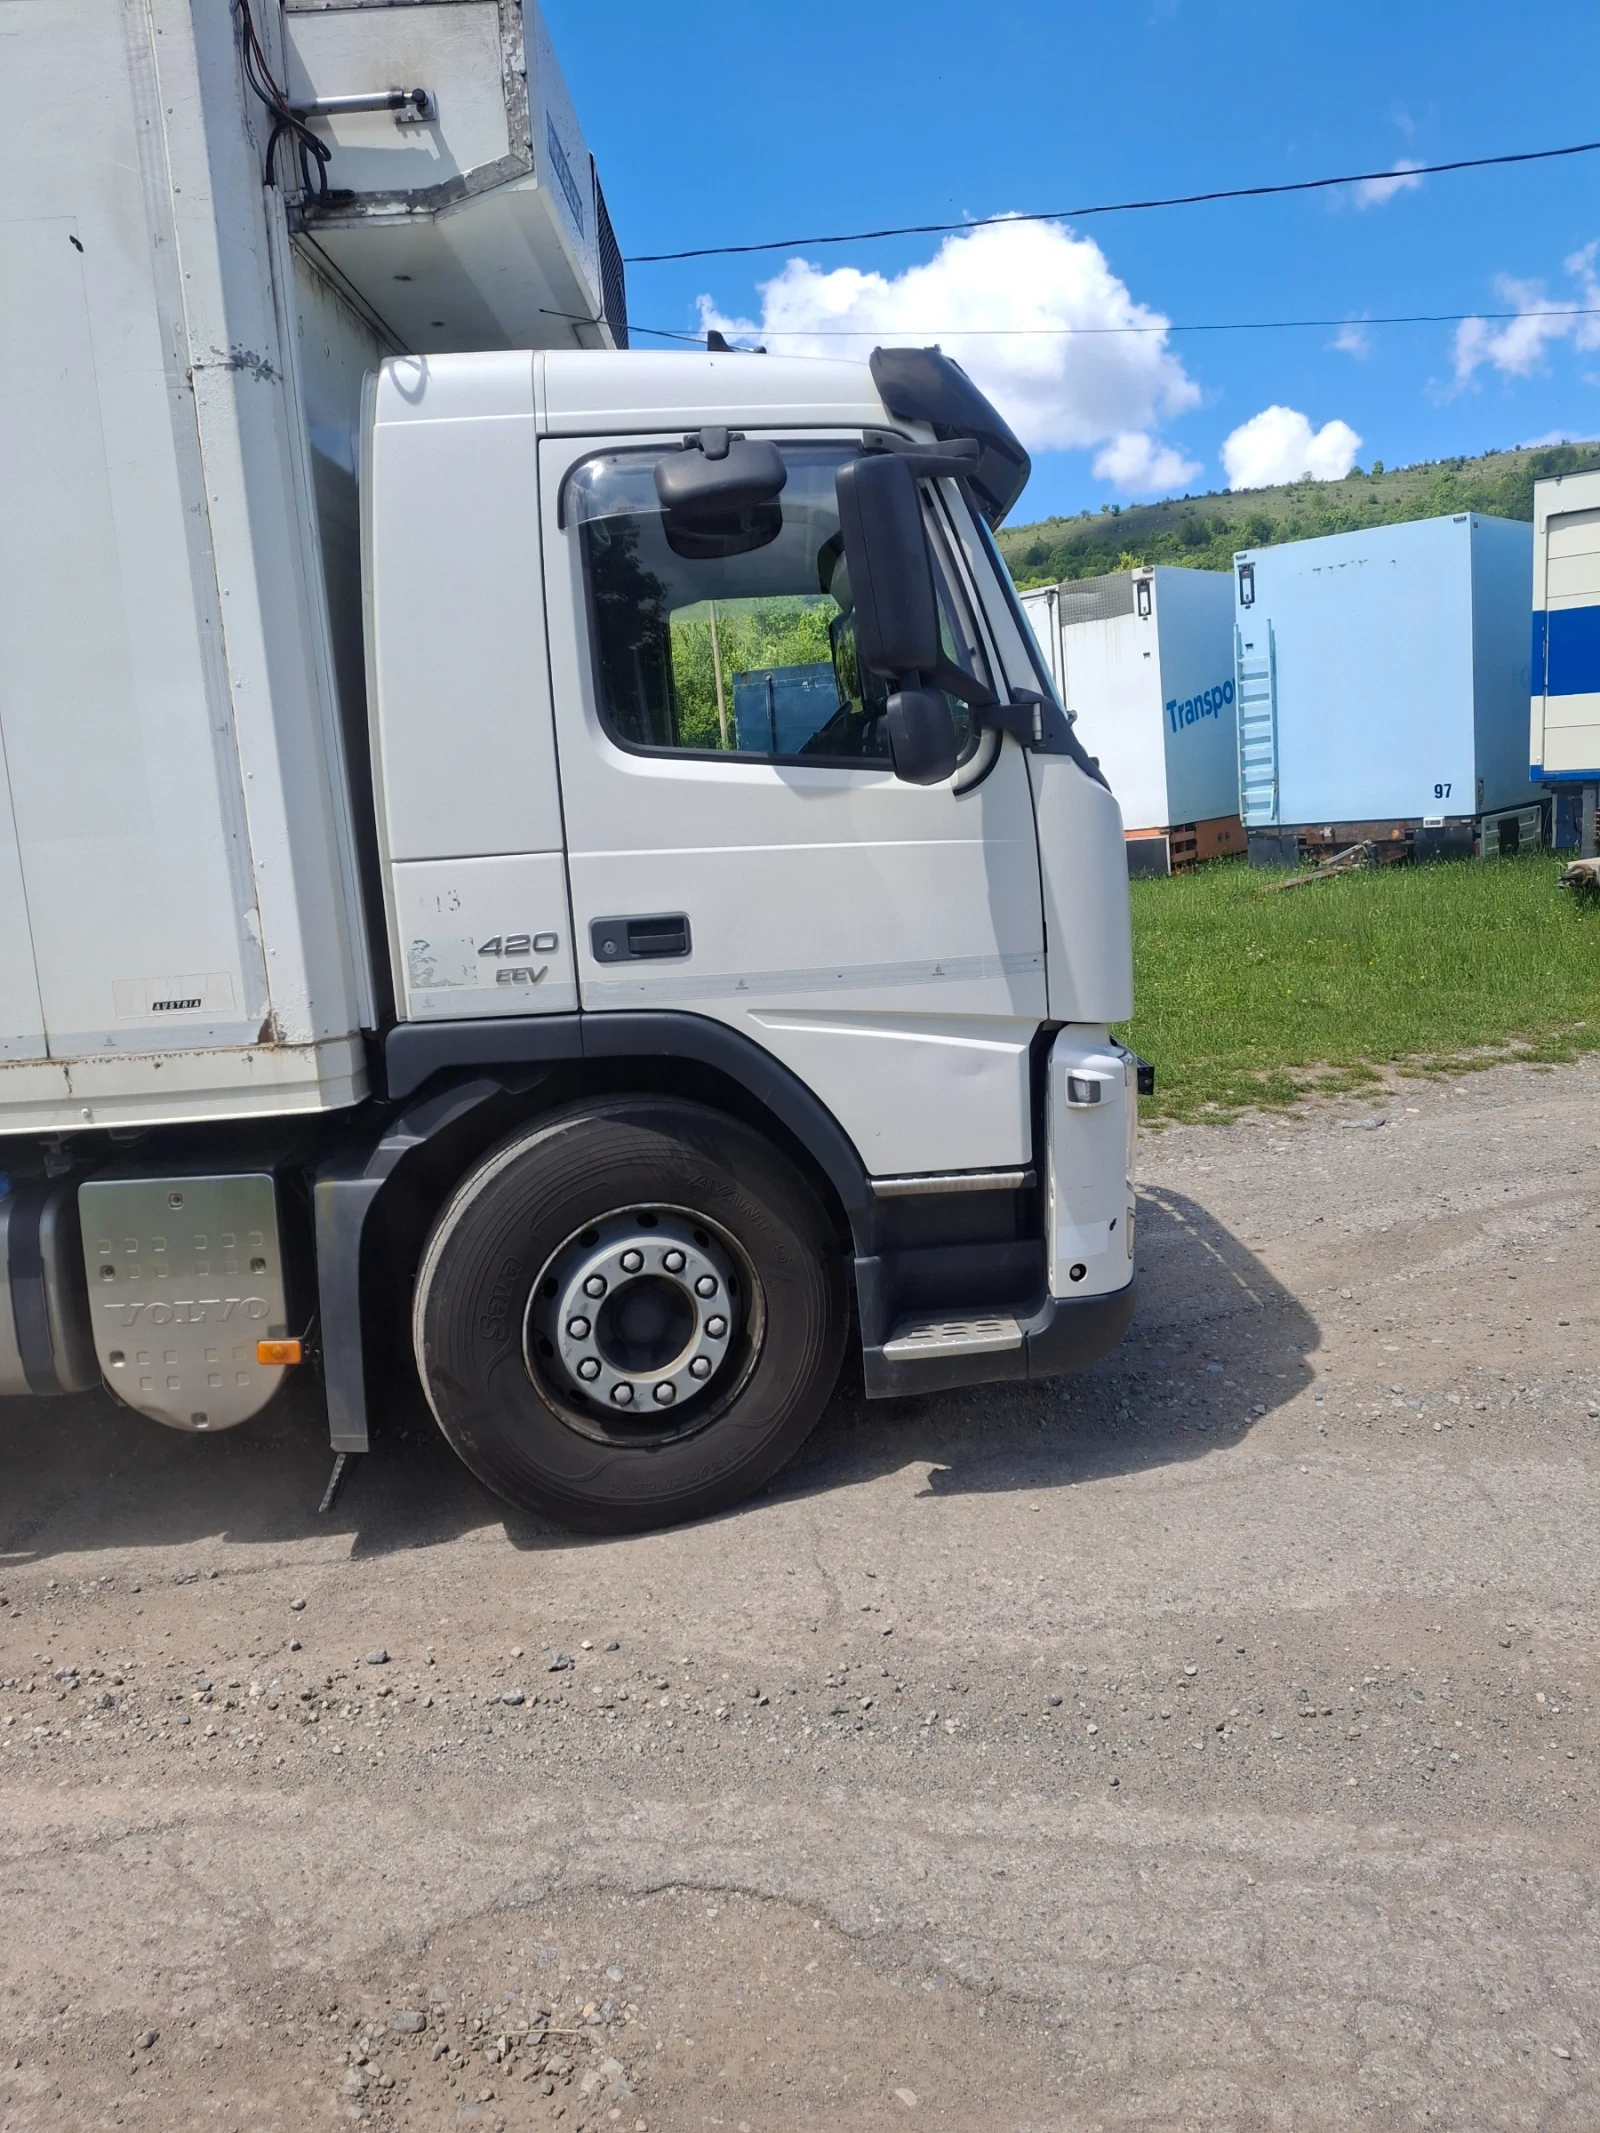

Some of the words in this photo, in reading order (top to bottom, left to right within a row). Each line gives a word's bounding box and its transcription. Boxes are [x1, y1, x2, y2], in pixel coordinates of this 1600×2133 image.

[1433, 783, 1452, 799] 97
[477, 931, 559, 959] 420
[495, 965, 549, 985] EEV
[153, 999, 201, 1011] AUSTRIA
[103, 1296, 271, 1327] VOLVO
